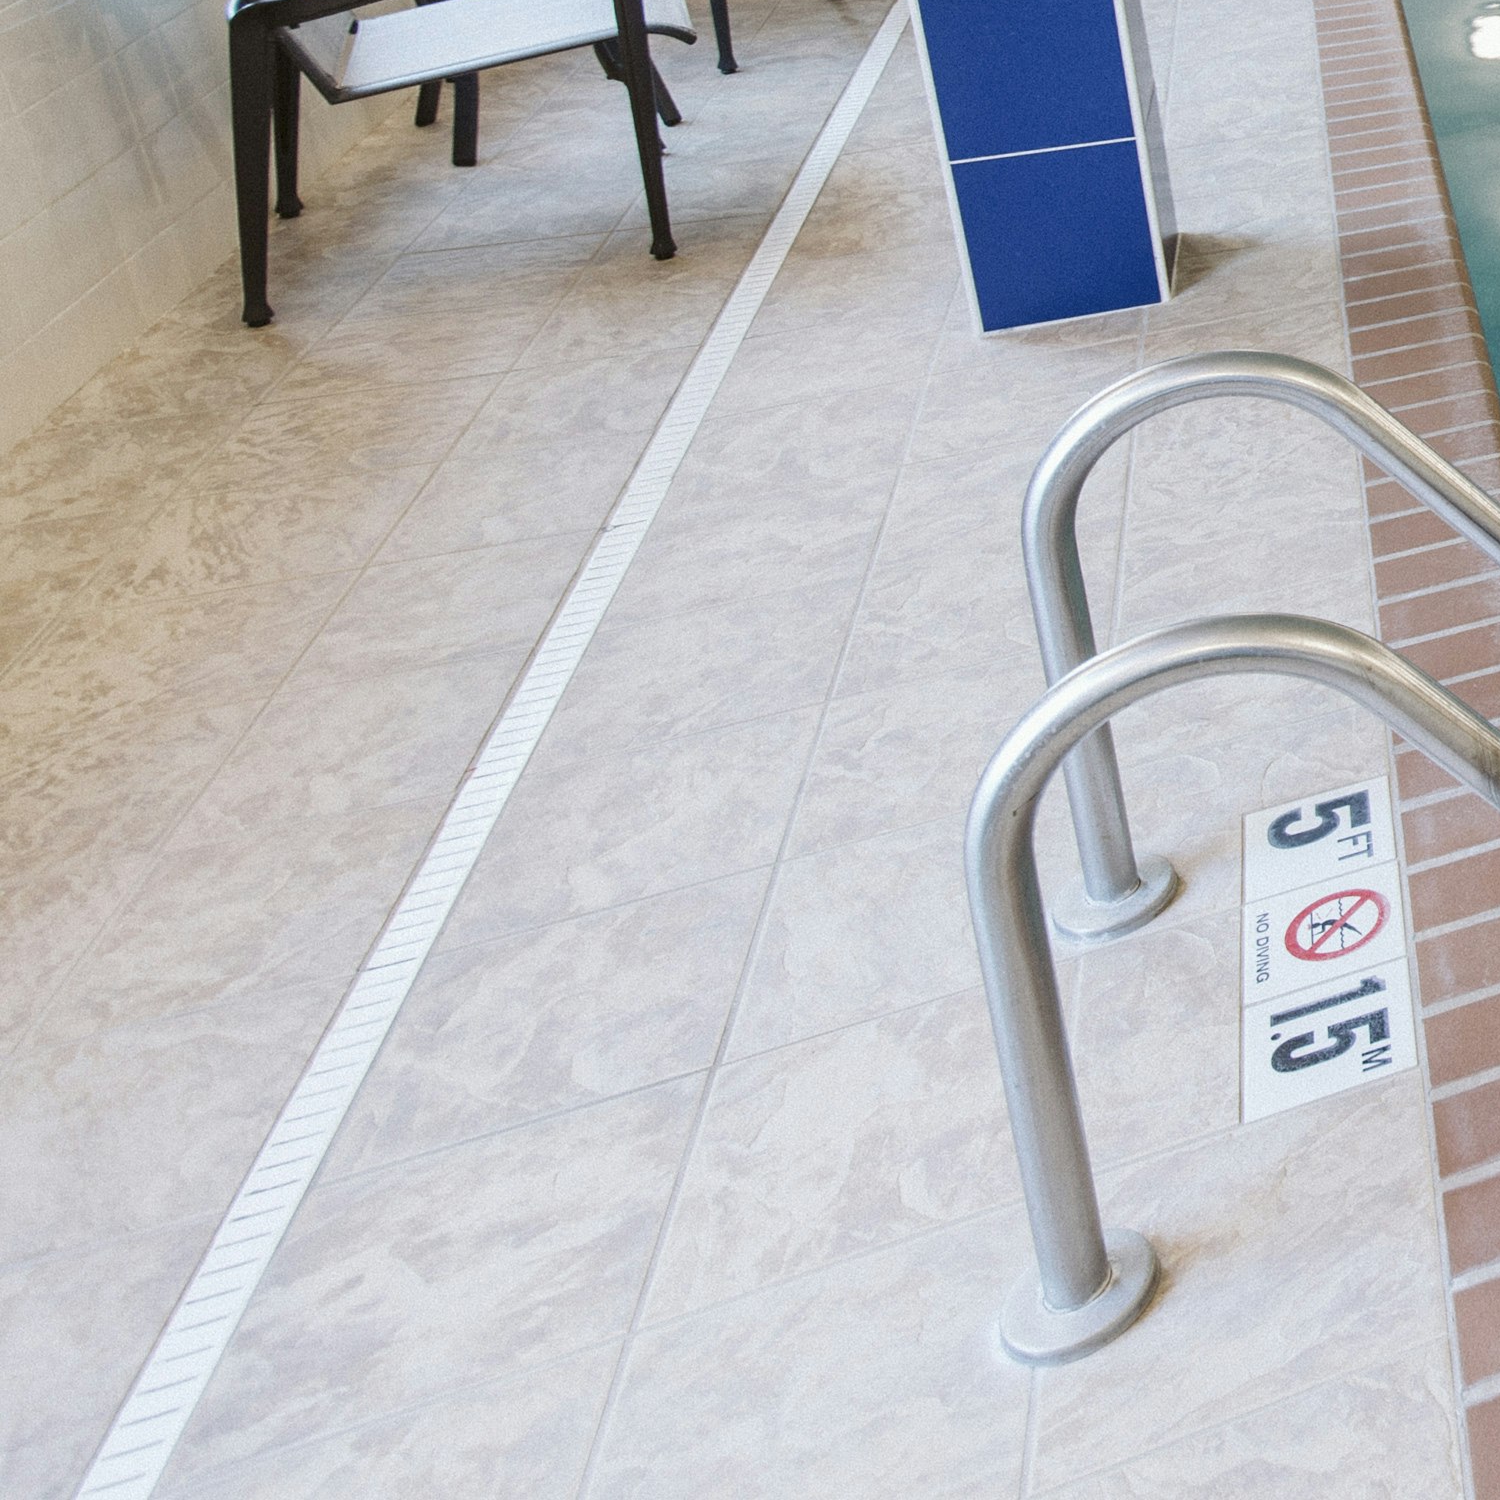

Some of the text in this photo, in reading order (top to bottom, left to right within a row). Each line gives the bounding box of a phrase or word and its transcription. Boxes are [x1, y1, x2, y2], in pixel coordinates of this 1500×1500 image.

[1267, 788, 1375, 861] 5 FT
[1255, 911, 1270, 984] NO DIVING
[1361, 1043, 1393, 1073] M
